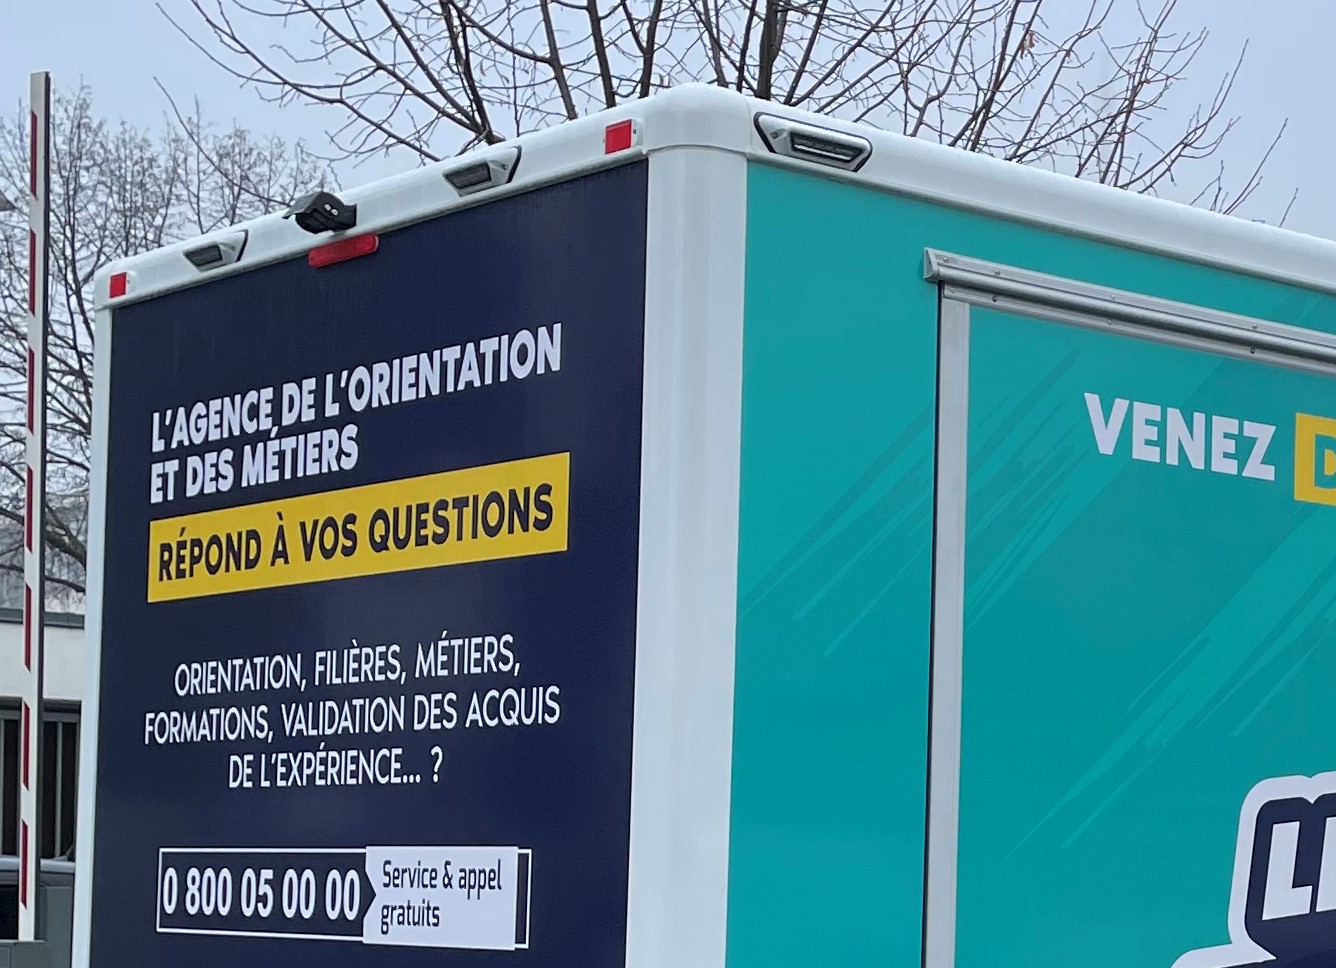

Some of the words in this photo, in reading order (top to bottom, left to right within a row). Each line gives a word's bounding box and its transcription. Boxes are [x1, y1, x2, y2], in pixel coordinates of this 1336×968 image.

[151, 385, 274, 452] L'AGENCE
[281, 377, 315, 424] DE
[324, 322, 561, 419] L'ORIENTATION
[150, 458, 179, 504] ET
[186, 448, 232, 499] DES
[242, 424, 358, 487] MÉTIERS
[1083, 392, 1277, 481] VENEZ
[158, 527, 261, 581] RÉPOND
[270, 511, 289, 566] À
[300, 513, 357, 562] VOS
[369, 483, 554, 552] QUESTIONS
[175, 653, 307, 696] ORIENTATION,
[314, 640, 405, 686] FILIÈRES,
[416, 631, 521, 677] MÉTIERS,
[145, 706, 273, 744] FORMATIONS,
[281, 696, 404, 737] VALIDATION
[414, 692, 457, 731] DES
[465, 686, 560, 728] ACQUIS
[229, 753, 256, 788] DE
[431, 746, 443, 782] ?
[163, 867, 178, 914] 0
[185, 867, 232, 916] 800
[241, 867, 274, 918] 05
[282, 868, 316, 919] 00
[325, 869, 361, 921] 00
[382, 859, 437, 888] Service
[442, 860, 454, 887] &
[458, 859, 502, 900] appel
[381, 900, 440, 935] gratuits
